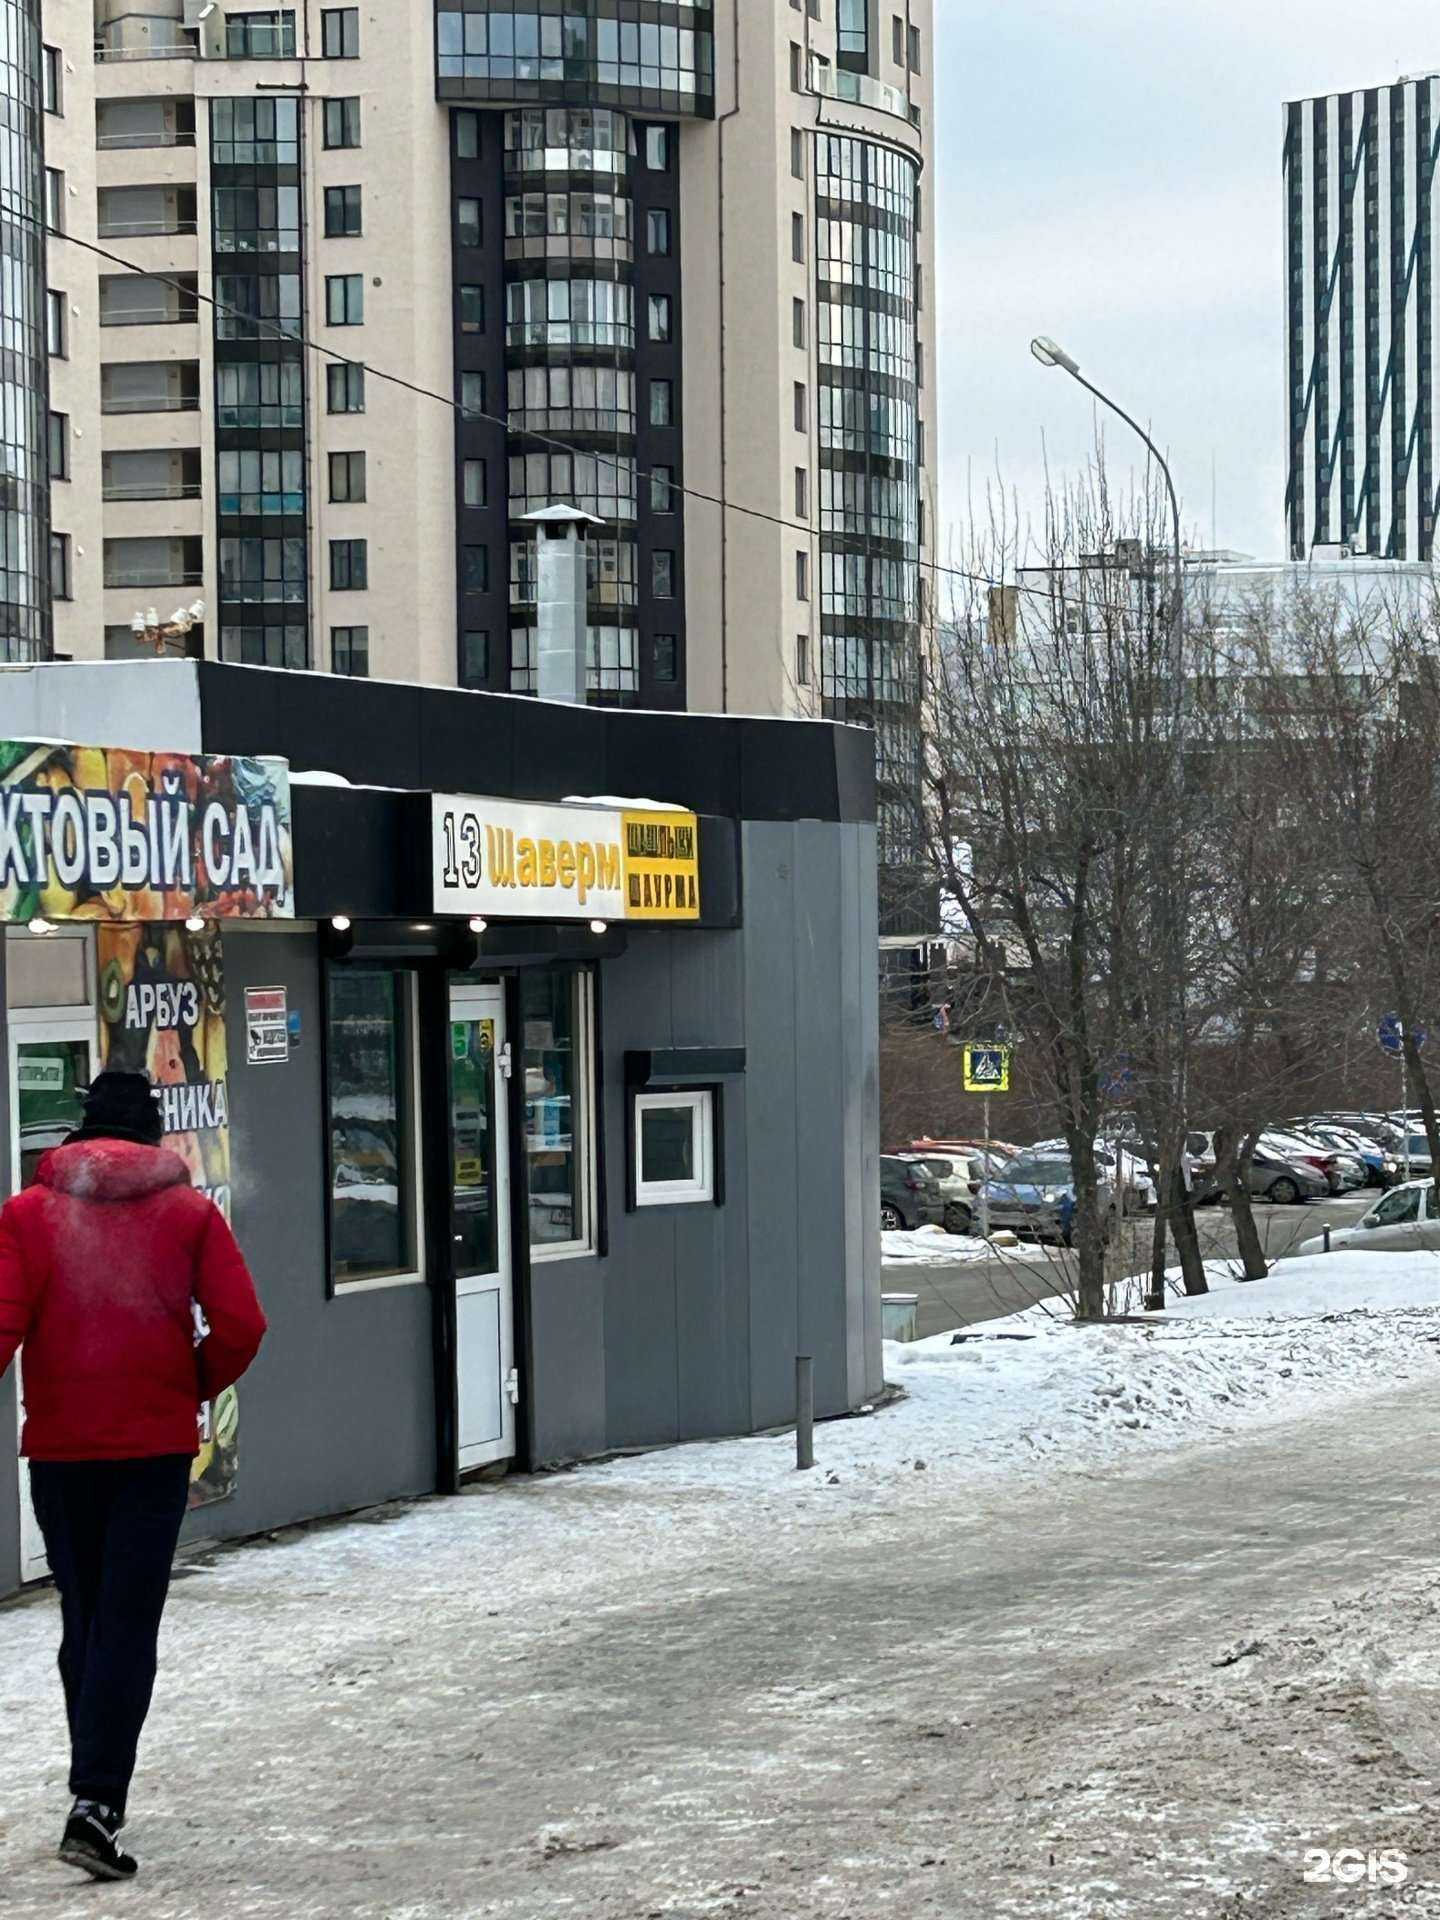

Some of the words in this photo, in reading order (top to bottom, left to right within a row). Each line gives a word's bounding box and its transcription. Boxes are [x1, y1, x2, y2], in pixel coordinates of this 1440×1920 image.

[0, 775, 192, 886] КТОВЫЙ
[203, 803, 285, 905] САД
[443, 811, 482, 889] 13
[485, 824, 622, 906] Шаверм
[125, 981, 200, 1030] АРБУЗ
[150, 1083, 228, 1132] НИКА
